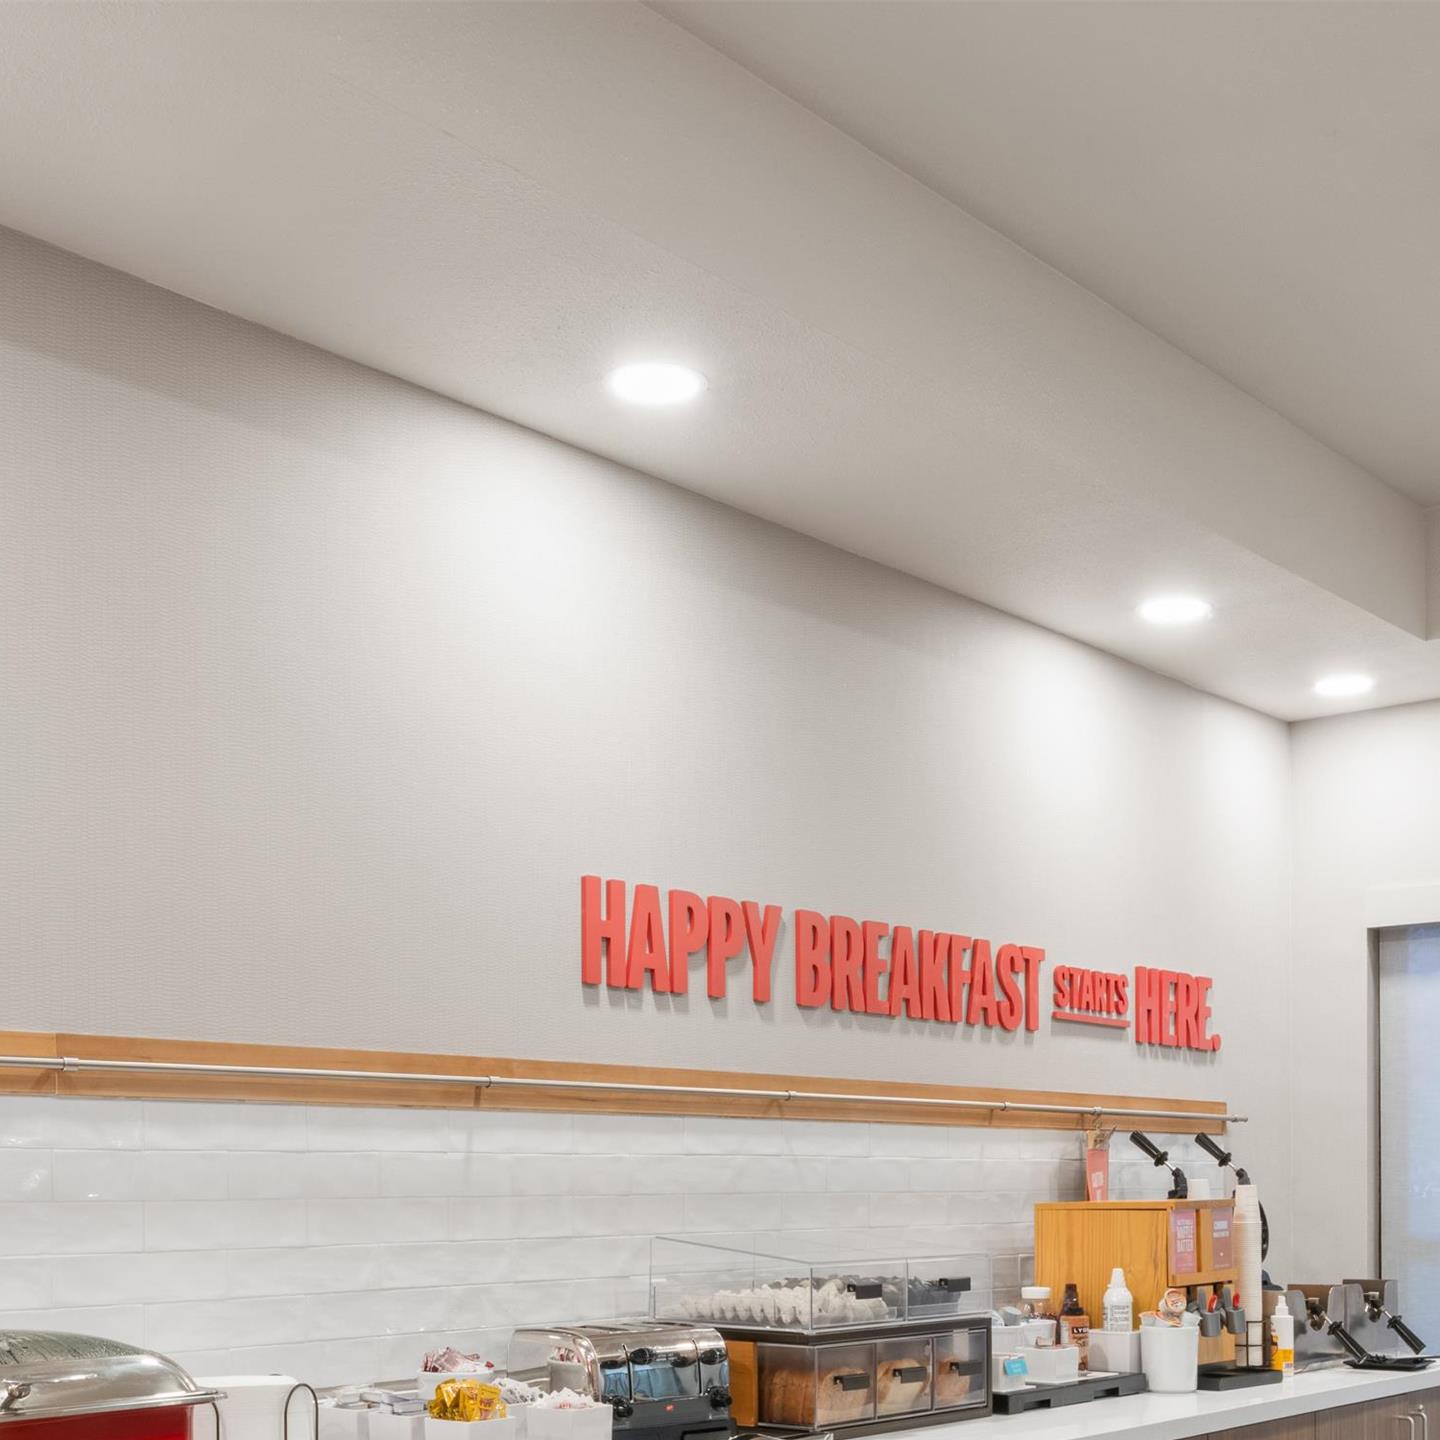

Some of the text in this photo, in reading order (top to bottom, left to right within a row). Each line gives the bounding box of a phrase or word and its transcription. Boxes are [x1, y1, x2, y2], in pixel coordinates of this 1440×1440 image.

[581, 875, 1222, 1052] HAPPY BREAKFAST STARTS HERE.
